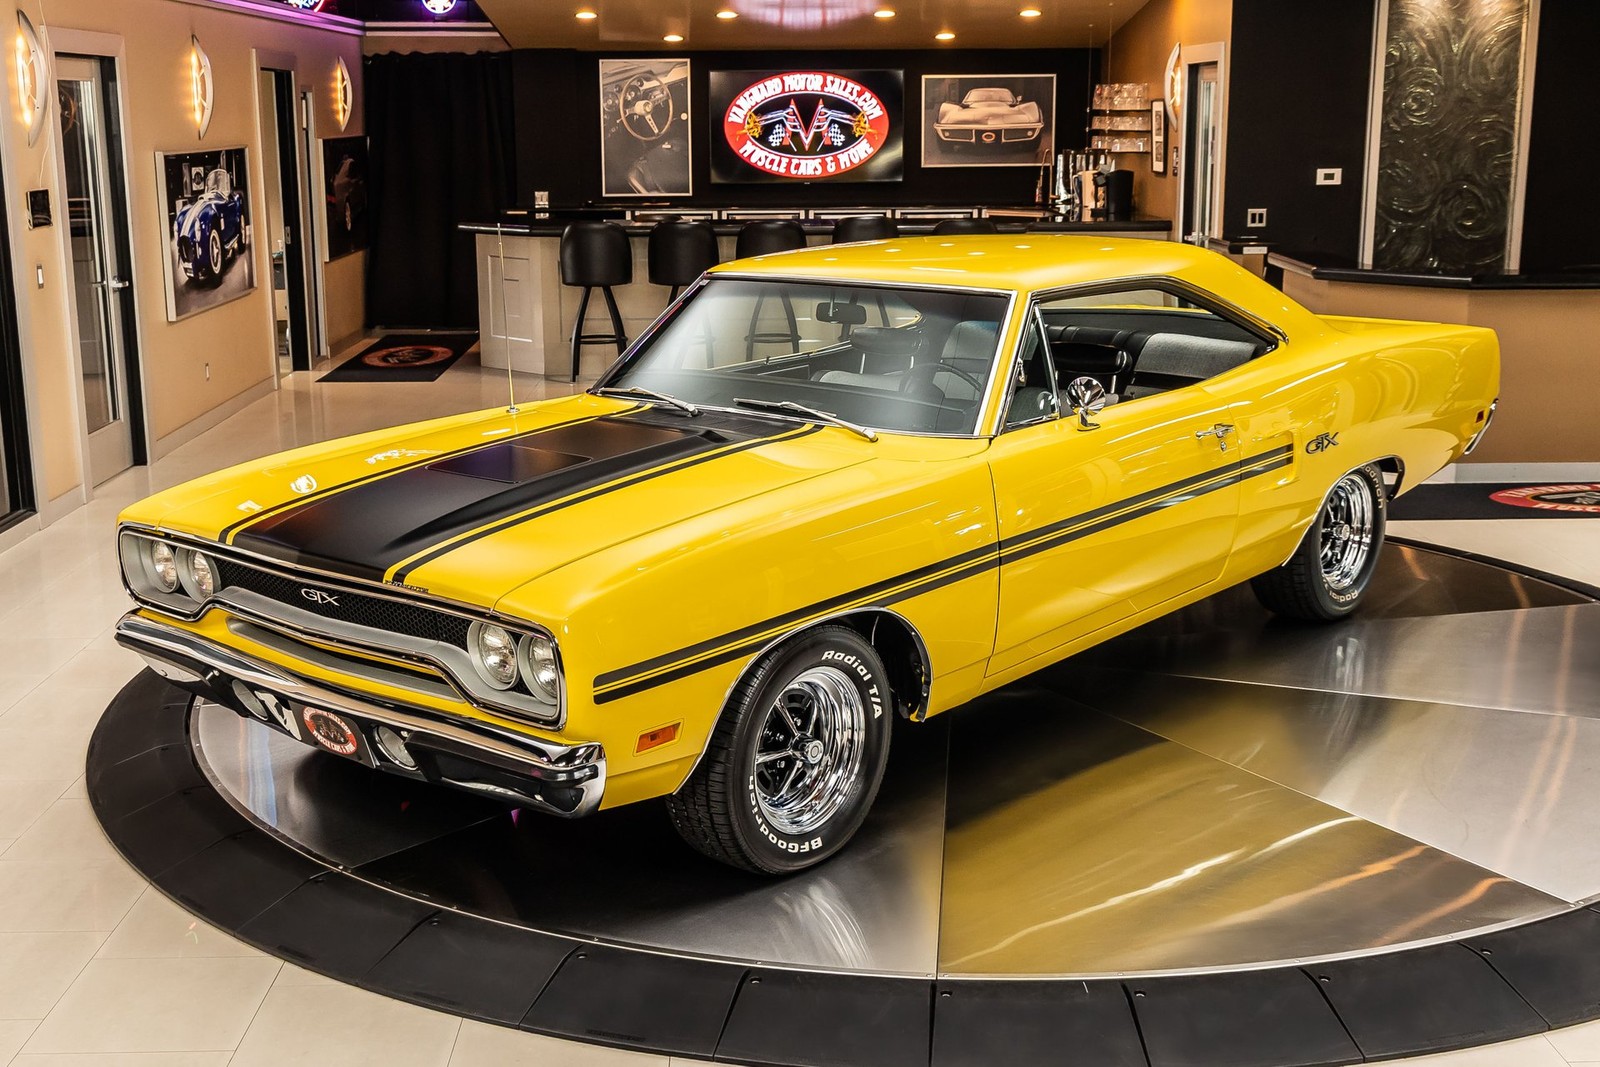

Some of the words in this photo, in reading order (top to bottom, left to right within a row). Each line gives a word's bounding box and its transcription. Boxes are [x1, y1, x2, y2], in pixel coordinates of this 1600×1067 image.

[728, 78, 783, 123] VANGUARD
[783, 74, 823, 92] MOTOR
[824, 76, 884, 120] SALES.COM
[739, 140, 789, 173] MUSCLE
[790, 158, 823, 175] CARS
[825, 156, 837, 173] &
[837, 138, 875, 170] MORE
[1304, 431, 1339, 454] GTX
[301, 588, 340, 606] GTX
[821, 650, 872, 681] Radial
[868, 684, 882, 719] T/A
[749, 775, 823, 853] BFGoodrich
